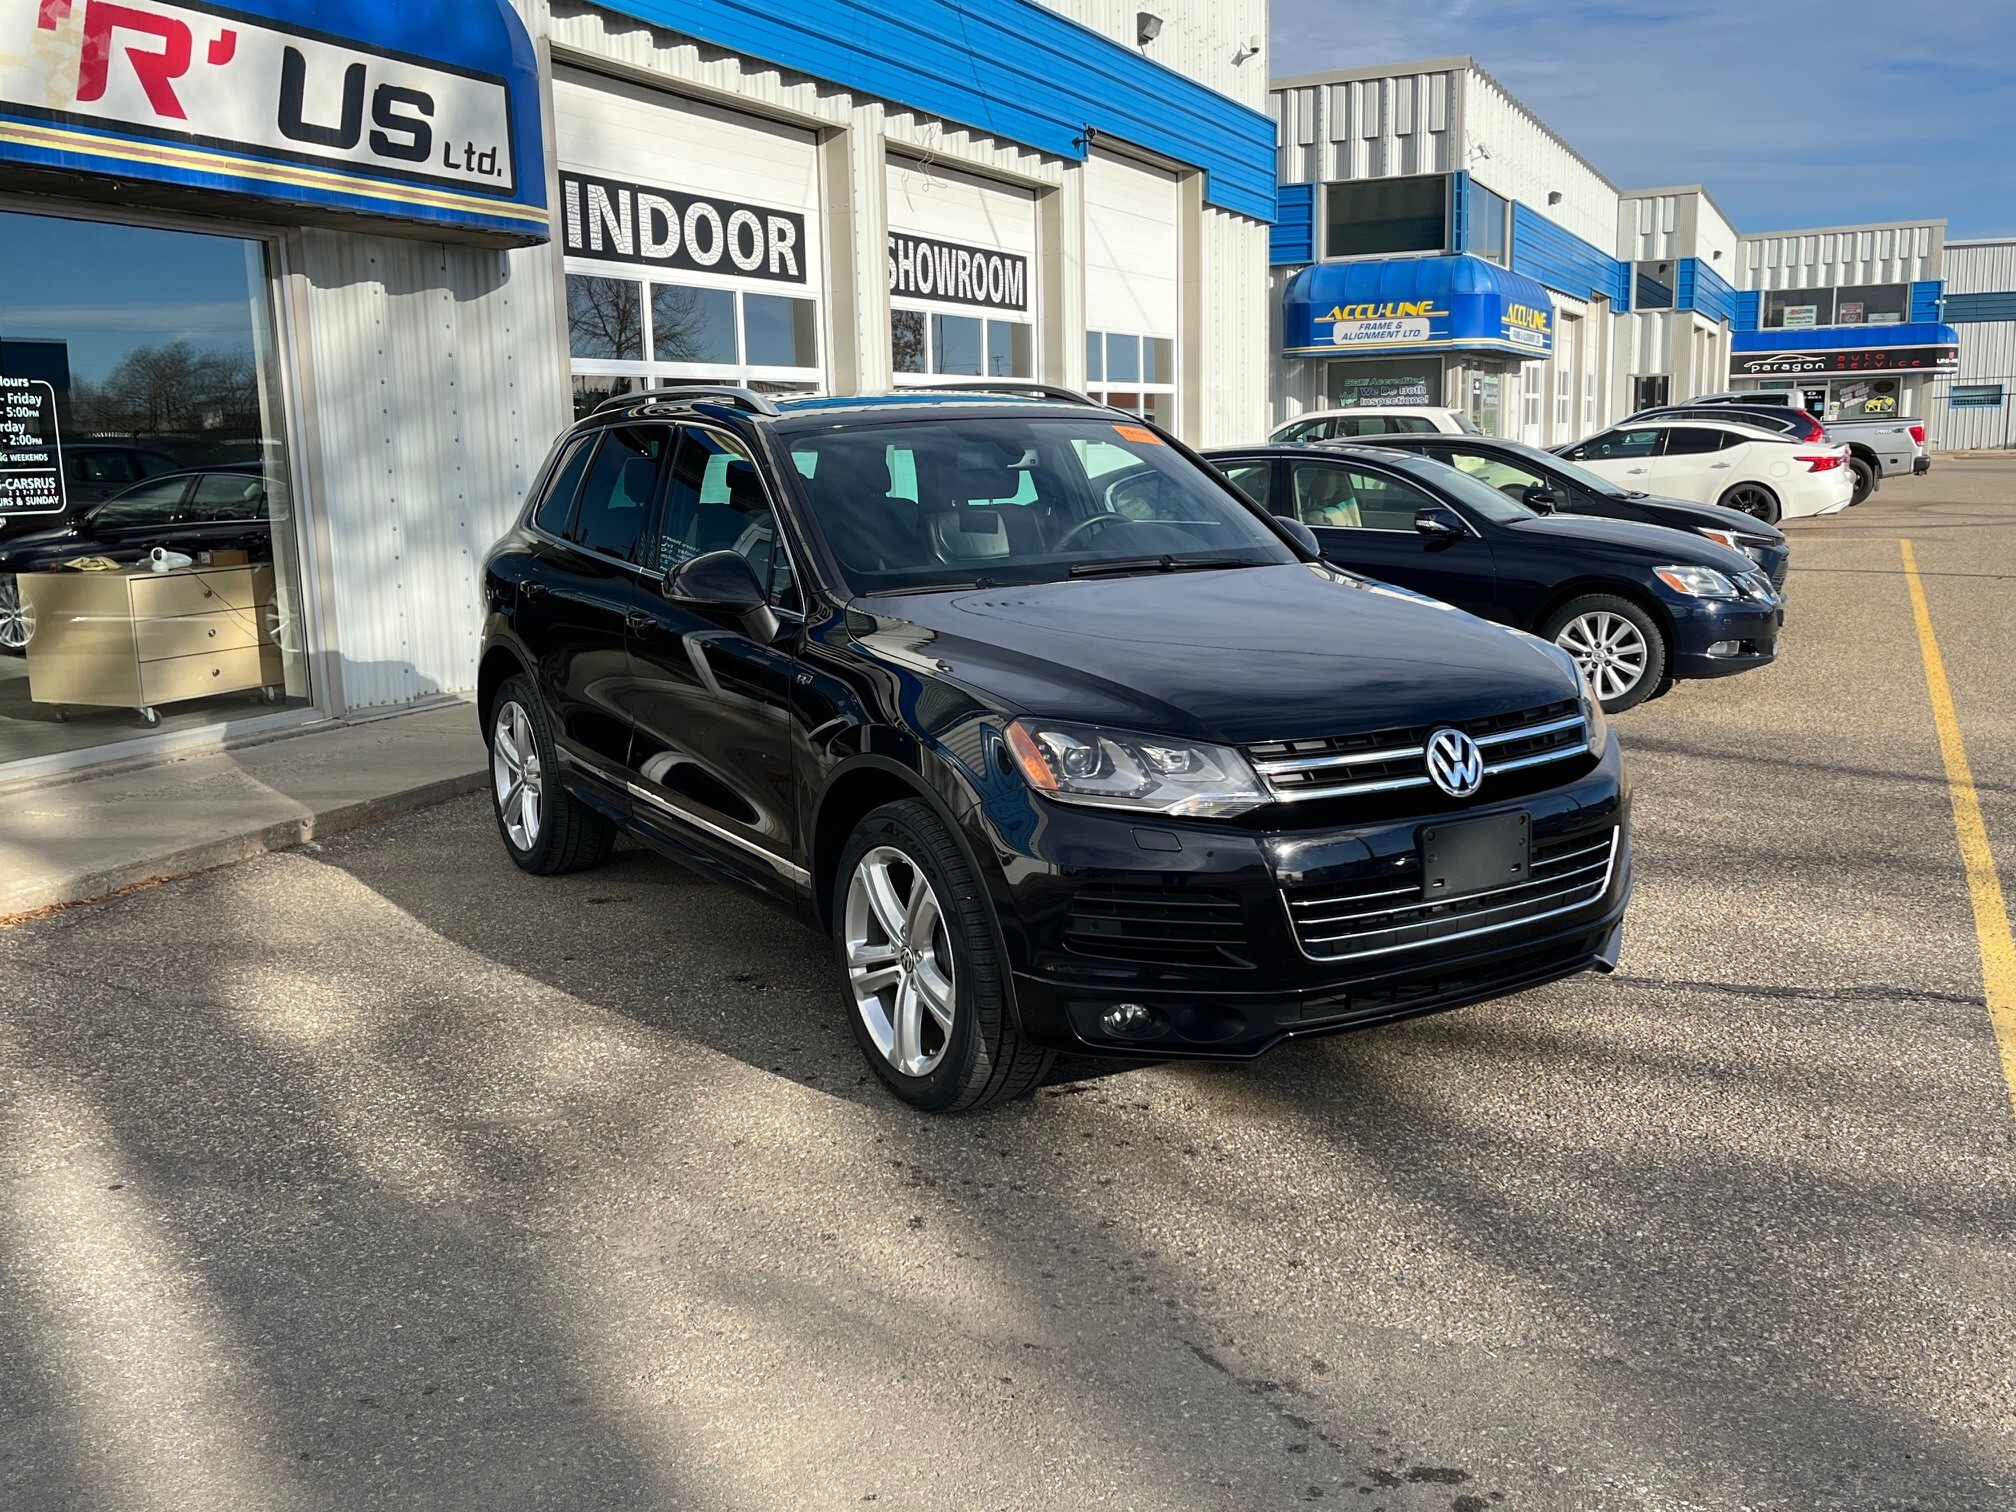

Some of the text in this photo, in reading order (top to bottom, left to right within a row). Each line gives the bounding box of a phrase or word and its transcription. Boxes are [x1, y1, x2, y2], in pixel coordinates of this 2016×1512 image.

[444, 142, 502, 177] Ltd.
[565, 180, 799, 276] INDOOR
[888, 236, 1024, 306] SHOWROOM
[1322, 300, 1438, 320] ACCU-LINE
[1358, 321, 1402, 331] FRAME &
[1341, 329, 1422, 340] ALIGNMENT LTD.
[1837, 352, 1885, 362] auto
[1751, 361, 1825, 374] paragon
[1837, 360, 1921, 369] service
[1360, 385, 1426, 396] We Do Both
[7, 392, 42, 408] Friday
[1360, 394, 1429, 406] Inspections!
[6, 406, 40, 418] 5:00PM
[10, 434, 42, 446] 2:00PM
[10, 453, 49, 462] WEEKENDS
[16, 496, 23, 506] &
[25, 495, 59, 506] SUNDAY
